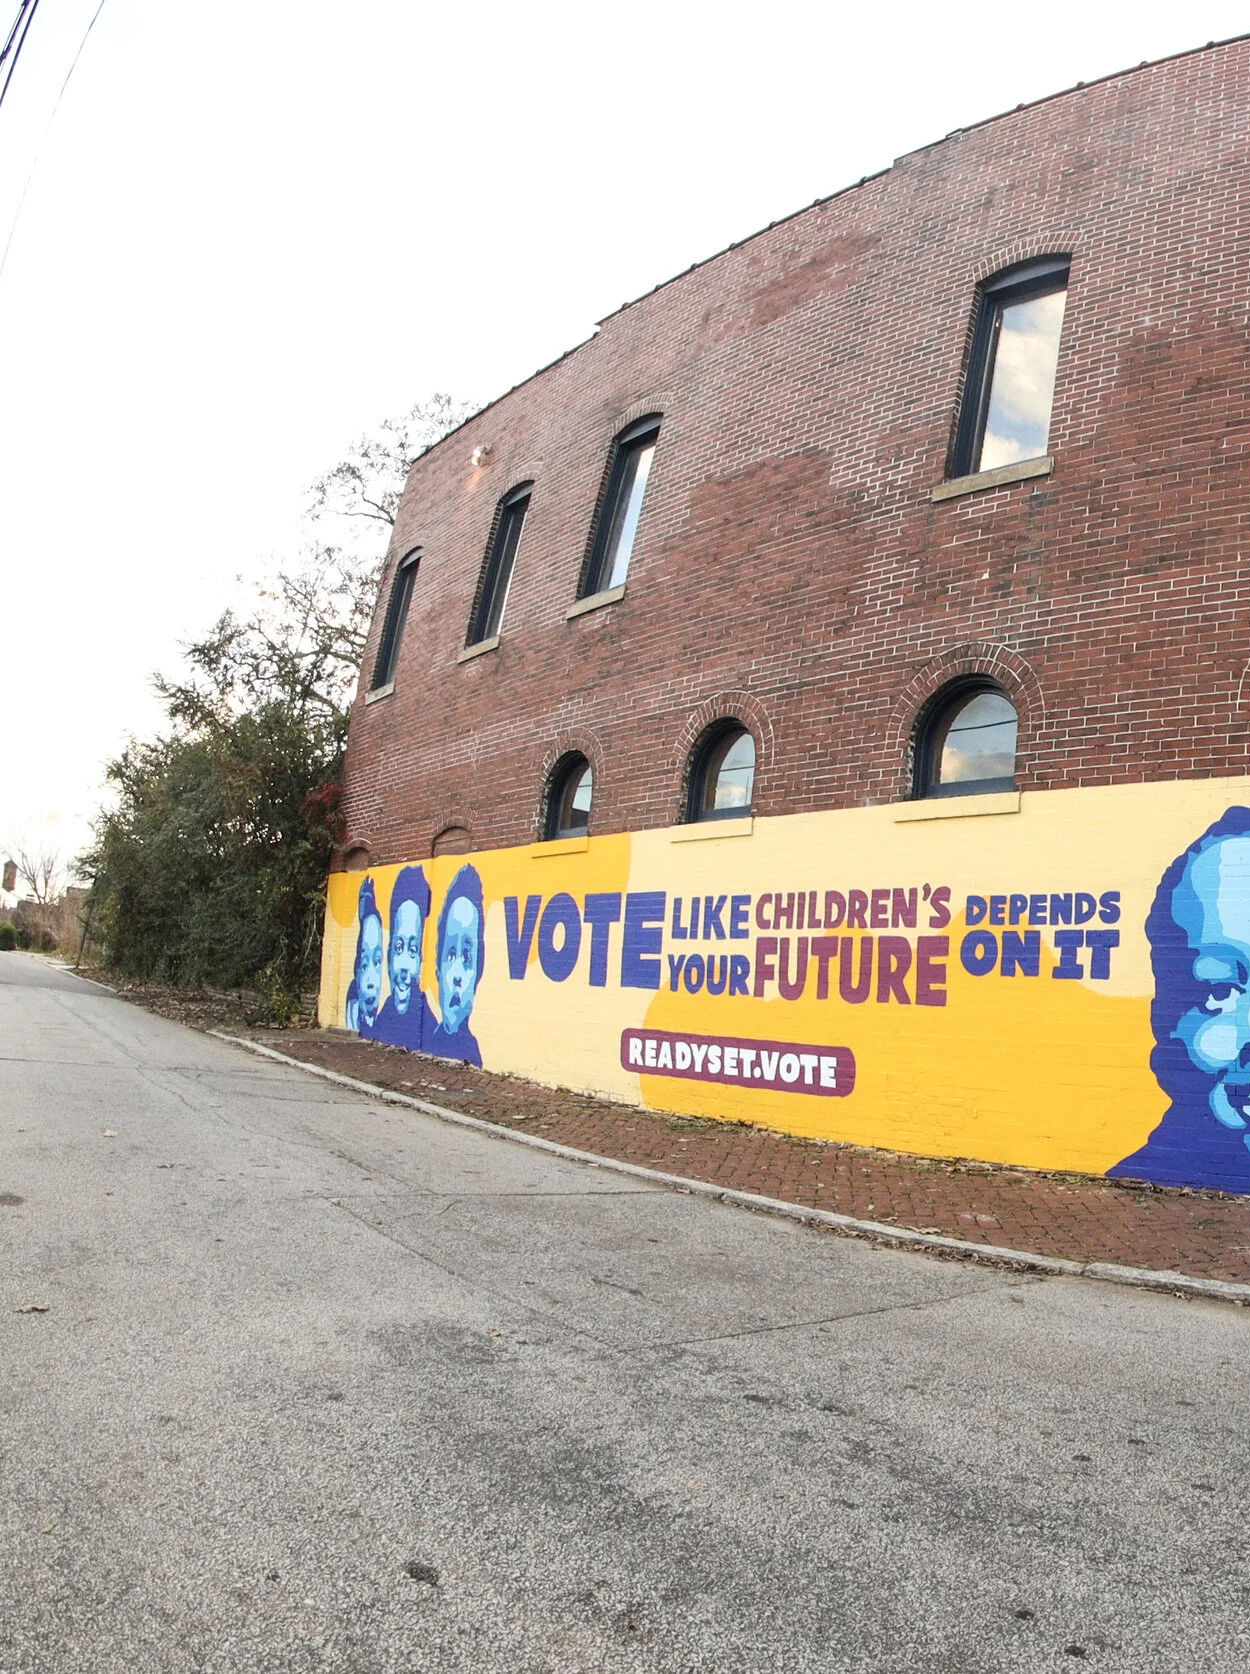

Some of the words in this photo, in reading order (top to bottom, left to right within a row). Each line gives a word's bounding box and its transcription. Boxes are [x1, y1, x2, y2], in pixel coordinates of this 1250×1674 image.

[669, 893, 752, 941] LIKE
[755, 882, 951, 933] CHILDREN'S
[964, 890, 1121, 927] DEPENDS
[502, 890, 667, 991] VOTE
[960, 929, 1041, 979] ON
[1050, 929, 1121, 980] IT
[667, 953, 752, 998] YOUR
[753, 935, 951, 1008] FUTURE
[628, 1037, 838, 1089] READYSET.VOTE
